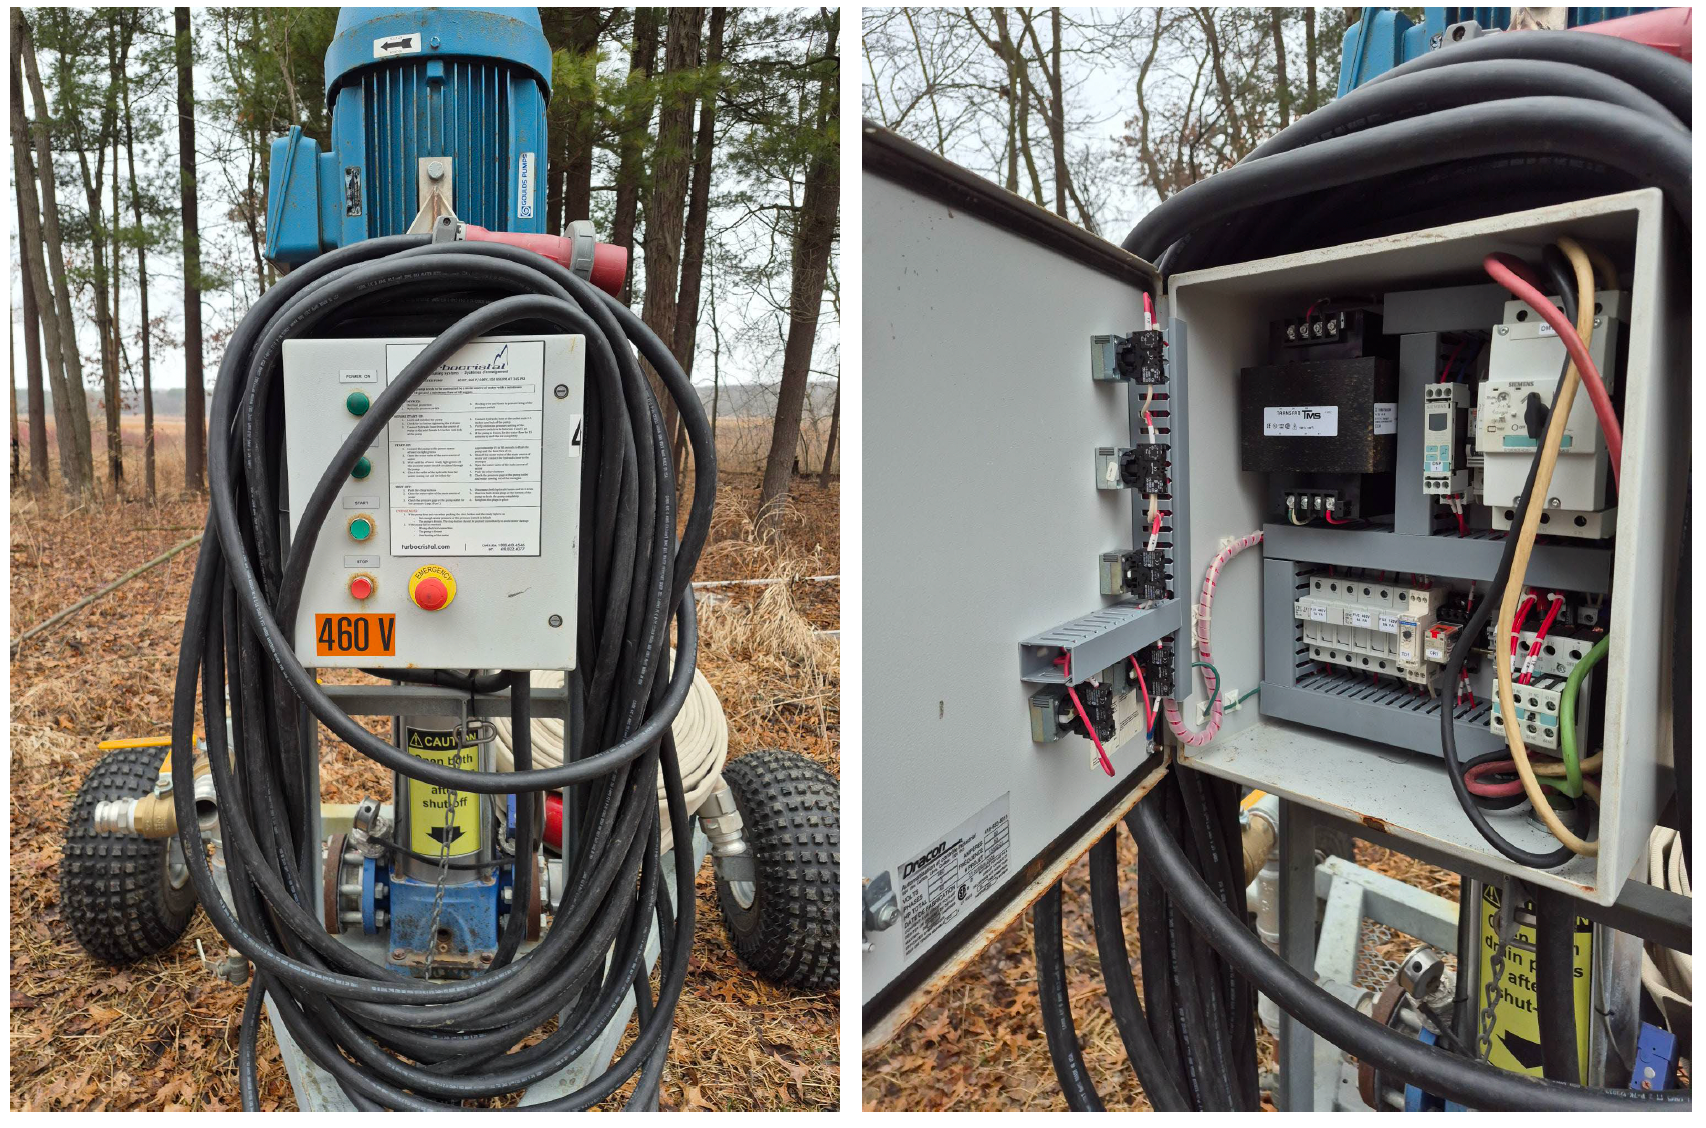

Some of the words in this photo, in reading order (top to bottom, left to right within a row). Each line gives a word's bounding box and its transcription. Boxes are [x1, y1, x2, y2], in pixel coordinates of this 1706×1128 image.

[440, 363, 506, 371] bocristal
[415, 566, 452, 580] EMERGENCY
[318, 617, 369, 651] 460
[379, 617, 395, 651] V
[424, 732, 477, 747] CAUTN
[422, 797, 467, 809] shutoff
[903, 841, 946, 879] Dracon
[902, 889, 918, 904] VOLTS
[902, 894, 923, 912] PHASES
[904, 915, 918, 928] DATE
[917, 908, 925, 917] DE
[925, 885, 955, 911] FABRICATION
[903, 911, 911, 920] HP
[911, 899, 927, 913] TOTAL
[1485, 935, 1522, 965] drin
[1508, 972, 1537, 992] afte
[1499, 988, 1537, 1013] shut-
